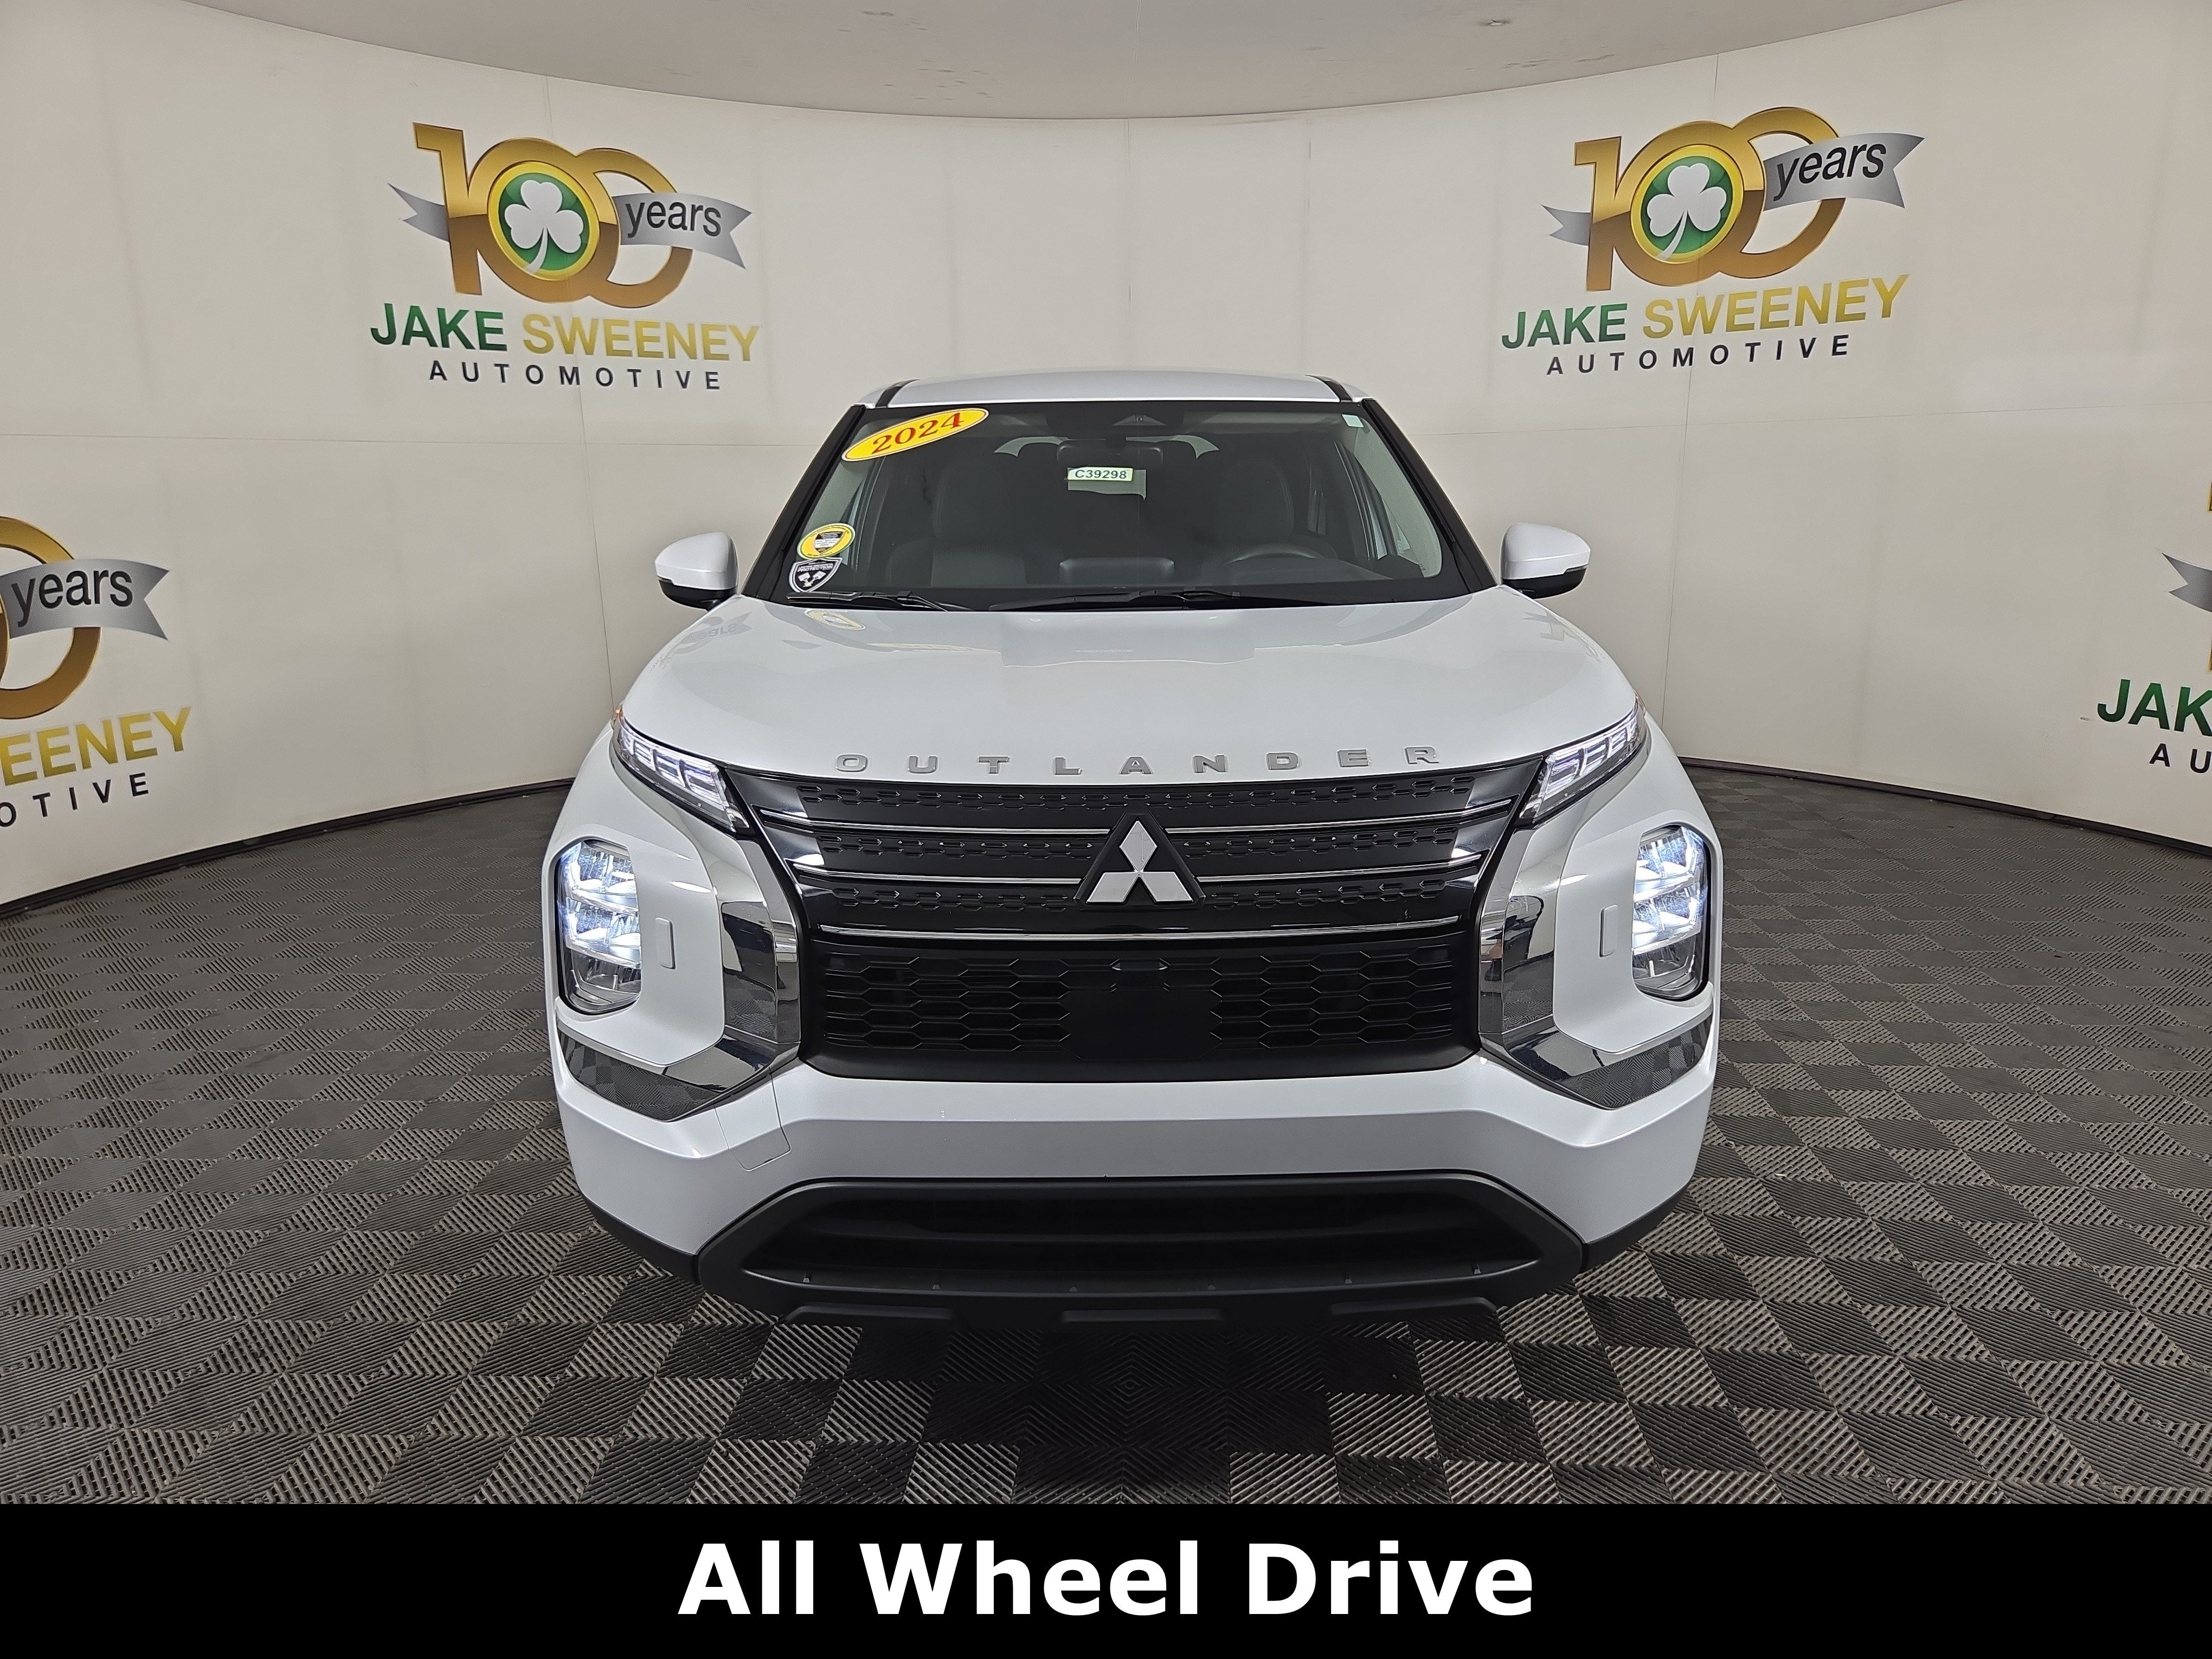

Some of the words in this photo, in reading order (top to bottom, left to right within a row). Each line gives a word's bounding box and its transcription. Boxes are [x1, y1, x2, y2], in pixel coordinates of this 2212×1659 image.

[413, 122, 695, 308] 100
[626, 201, 723, 239] years
[1574, 106, 1846, 292] 100
[1773, 143, 1887, 201] years
[370, 302, 507, 352] JAKE
[523, 313, 759, 362] SWEENEY
[1501, 303, 1628, 349] JAKE
[1642, 274, 1909, 339] SWEENEY
[429, 360, 721, 390] AUTOMOTIVE
[1546, 335, 1850, 375] AUTOMOTIVE
[871, 412, 964, 455] 2024
[1075, 470, 1127, 479] C39298
[11, 569, 133, 628] years
[835, 746, 1440, 775] OUTLANDER
